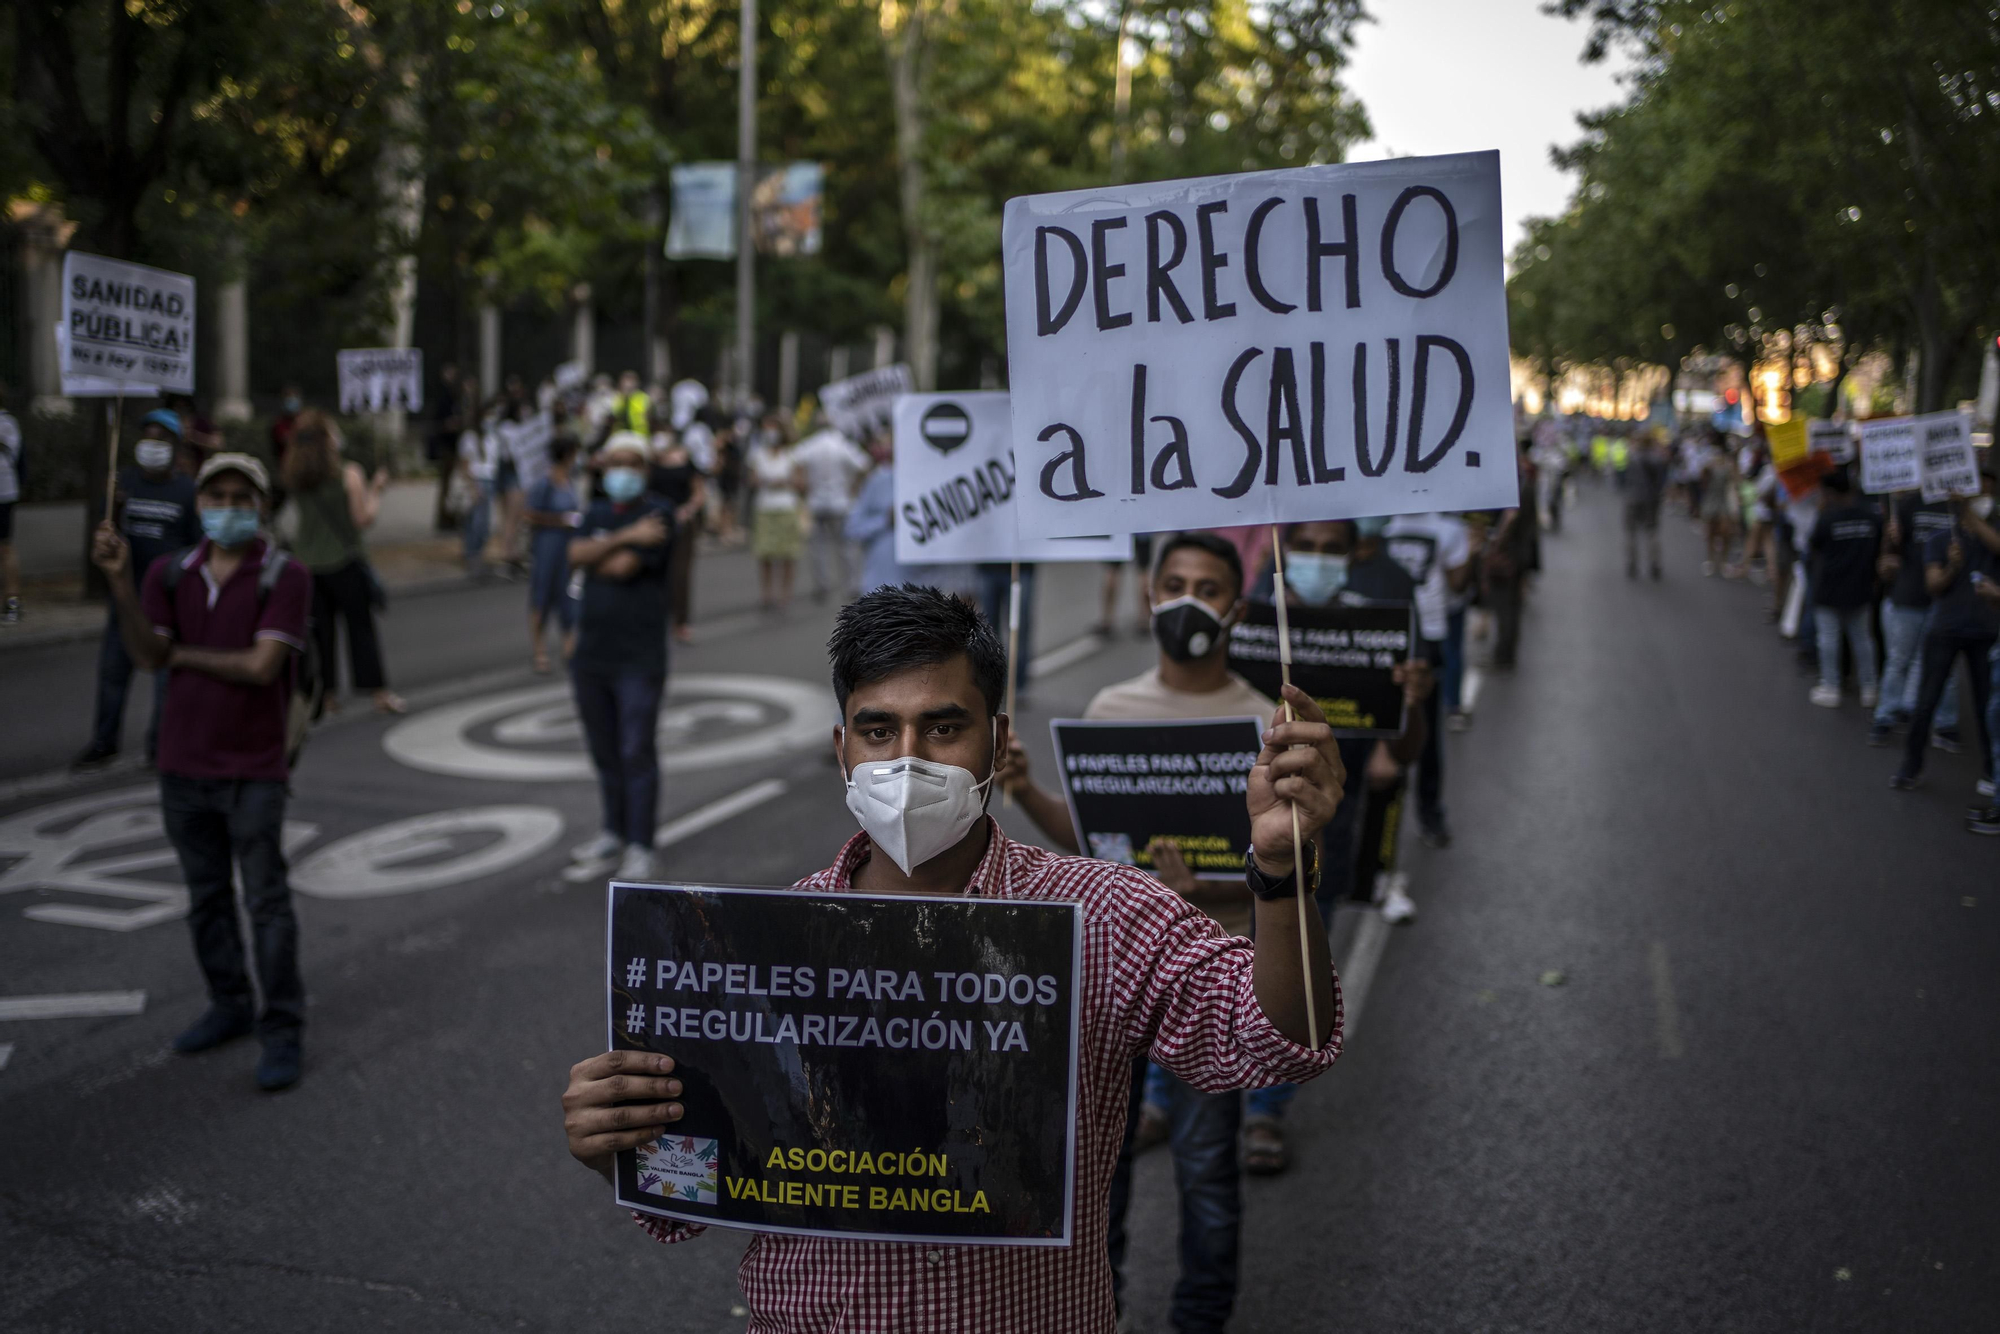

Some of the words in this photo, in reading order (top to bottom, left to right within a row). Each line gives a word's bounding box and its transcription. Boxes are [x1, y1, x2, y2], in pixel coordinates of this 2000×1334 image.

[1034, 185, 1459, 337] DERECHO
[1037, 423, 1106, 501] a
[1131, 363, 1198, 495] la
[1212, 335, 1481, 499] SALUD.
[1077, 754, 1149, 774] PAPELES
[1150, 754, 1198, 774] PARA
[656, 960, 815, 998] PAPELES
[828, 967, 926, 1001] PARA
[934, 972, 1058, 1006] TODOS
[655, 1006, 972, 1051] REGULARIZACIÓN
[983, 1021, 1029, 1052] YA
[650, 1166, 678, 1175] VALIENTE
[679, 1170, 705, 1179] BANGLA
[766, 1146, 947, 1177] ASOCIACIÓN
[725, 1176, 861, 1207] VALIENTE
[869, 1187, 991, 1213] BANGLA
